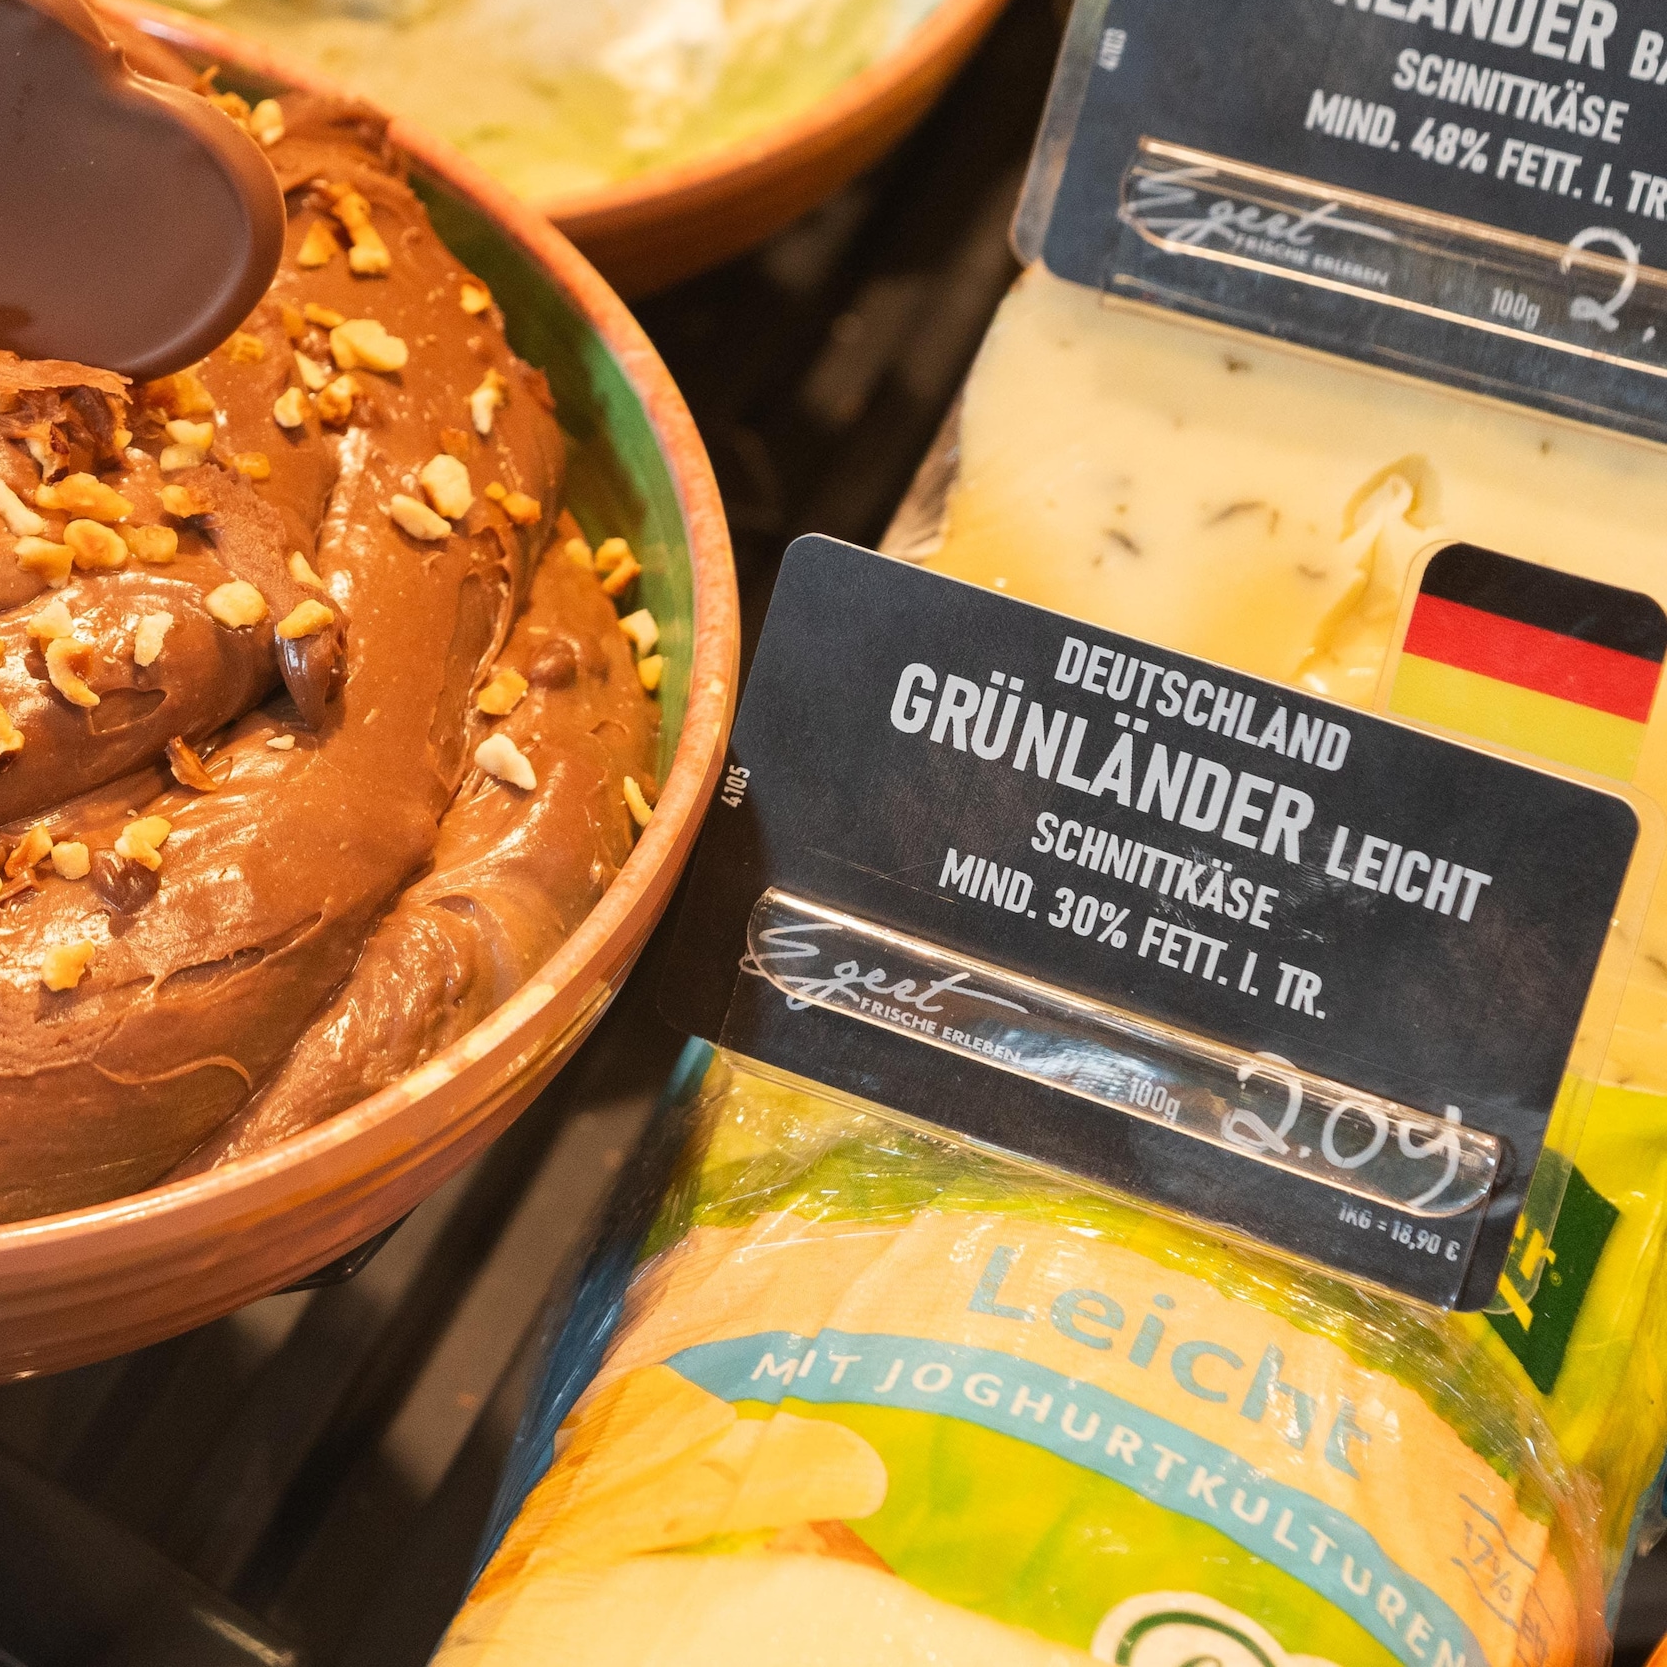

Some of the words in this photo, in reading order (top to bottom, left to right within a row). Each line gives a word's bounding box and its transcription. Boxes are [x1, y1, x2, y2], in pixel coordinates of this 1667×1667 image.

[1304, 88, 1401, 153] MIND.
[1410, 117, 1491, 173] 48%
[1496, 138, 1583, 199] FETT.
[1593, 164, 1614, 207] I.
[1392, 47, 1630, 144] SCHNITTKÄSE
[1234, 233, 1309, 266] FRISCHE
[1312, 254, 1389, 286] ERLEBEN
[1490, 287, 1540, 331] 100g
[1054, 636, 1352, 771] DEUTSCHLAND
[721, 765, 750, 808] 4105
[890, 662, 1315, 864] GRÜNLÄNDER
[1325, 825, 1493, 922] LEICHT
[1031, 812, 1280, 929] SCHNITTKÄSE
[939, 848, 1036, 919] MIND.
[1047, 887, 1128, 950] 30%
[1138, 916, 1228, 986] FETT.
[1237, 951, 1259, 996] I.
[1274, 961, 1326, 1020] TR.
[859, 997, 936, 1035] FRISCHE
[942, 1026, 1022, 1063] ERLEBEN
[1128, 1076, 1181, 1125] 100g
[1338, 1201, 1372, 1229] 1KG
[1390, 1219, 1441, 1256] 18,90
[968, 1245, 1372, 1480] Leicht
[750, 1348, 861, 1387] MIT
[873, 1358, 1468, 1667] JOGHURTKULTUREN
